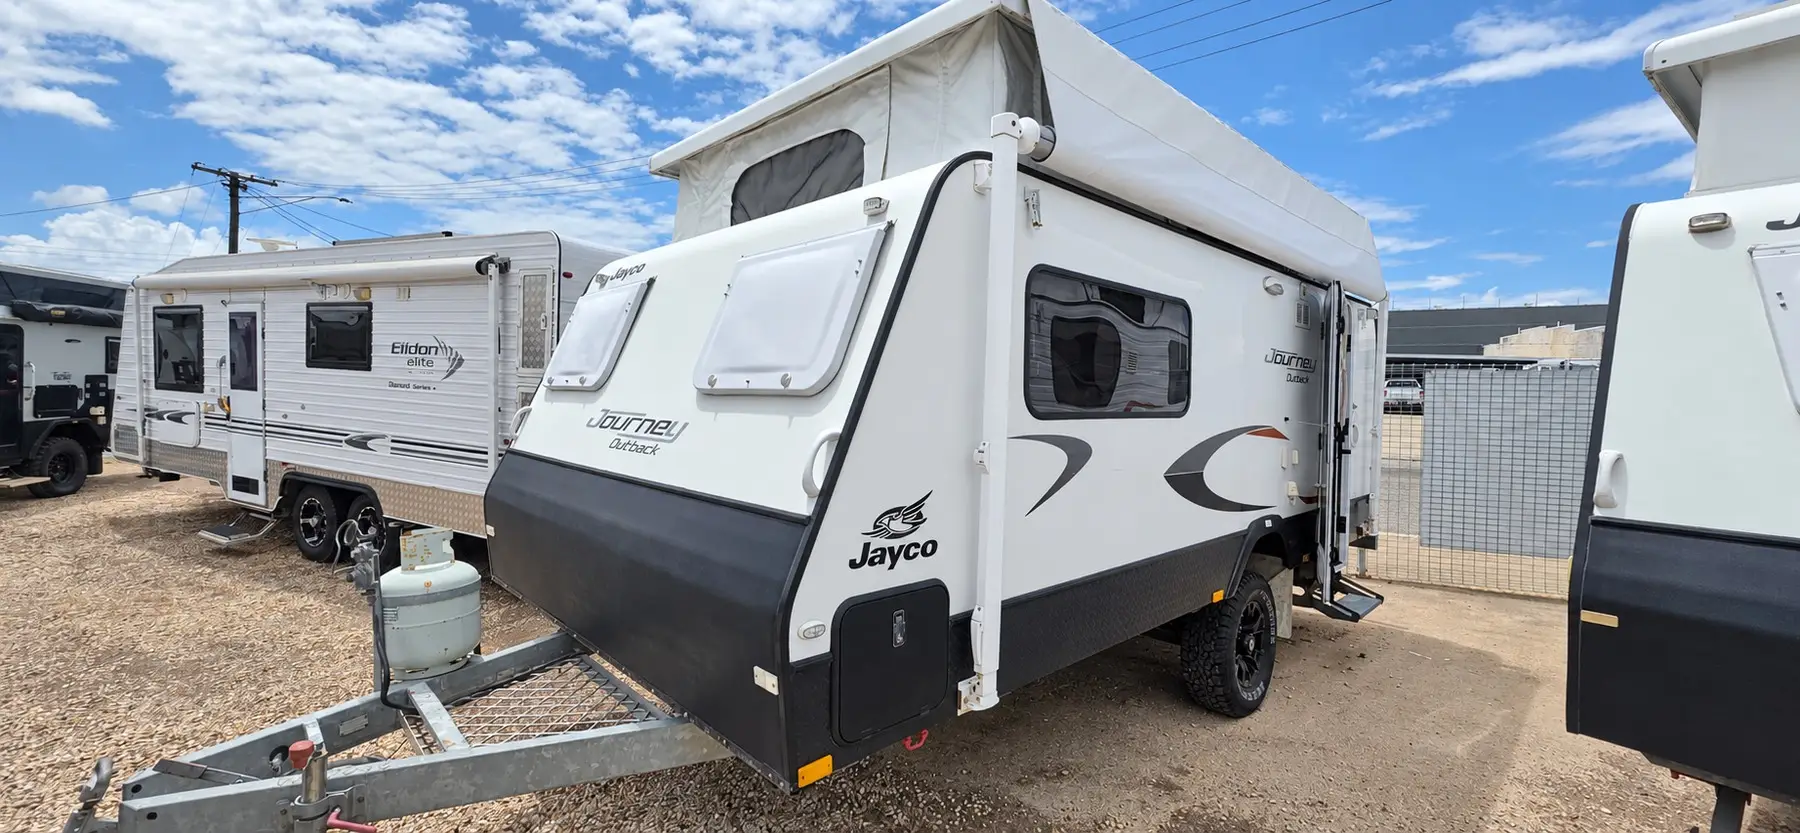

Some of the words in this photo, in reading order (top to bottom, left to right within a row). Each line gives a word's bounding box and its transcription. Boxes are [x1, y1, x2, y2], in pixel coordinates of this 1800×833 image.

[609, 263, 646, 281] Jayco
[391, 342, 439, 356] Eildon
[407, 356, 434, 368] elite
[1264, 347, 1317, 373] Journey
[586, 409, 689, 443] Journey
[609, 437, 660, 456] Outback
[848, 539, 939, 571] Jayco
